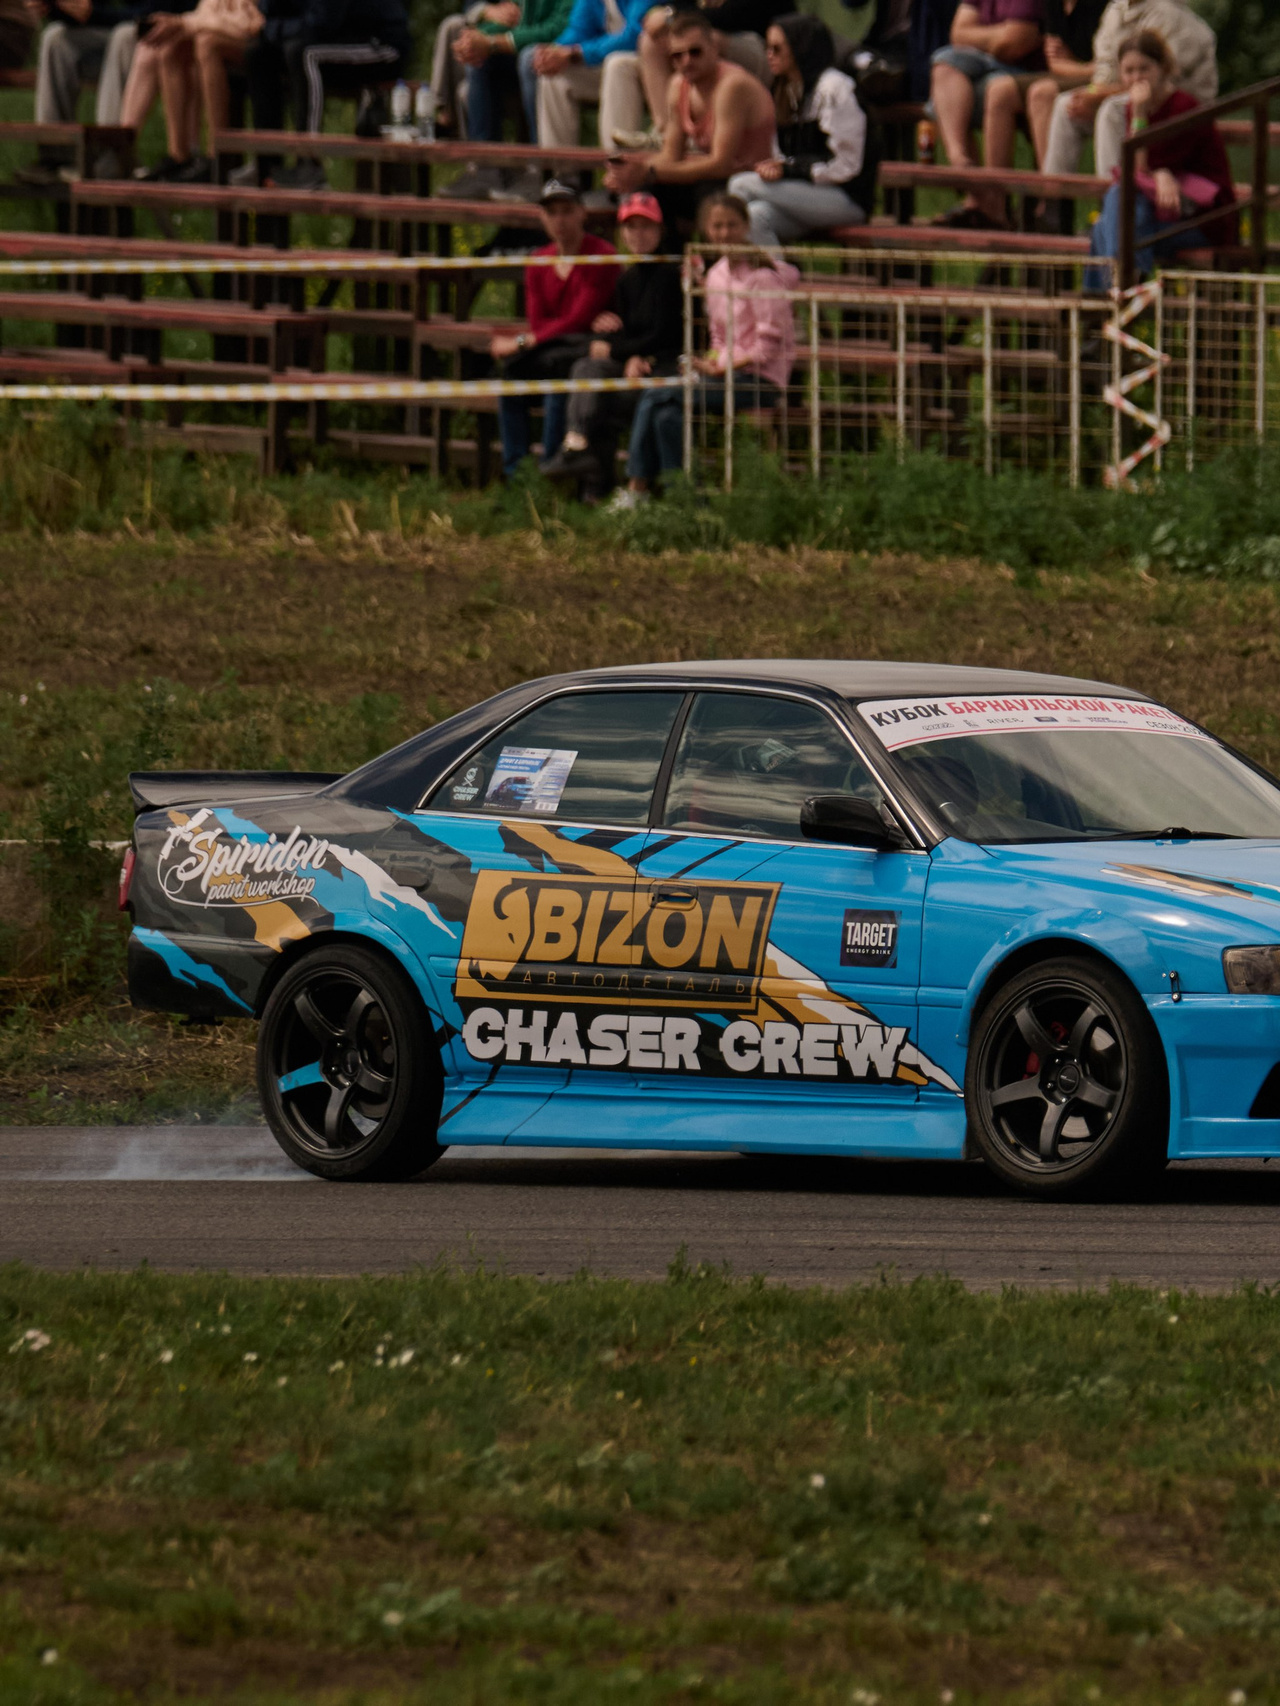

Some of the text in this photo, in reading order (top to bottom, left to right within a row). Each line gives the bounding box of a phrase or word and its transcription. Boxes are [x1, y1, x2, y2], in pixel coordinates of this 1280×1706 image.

[870, 704, 947, 727] КУБОК
[945, 698, 1112, 714] БАРНАУЛЬСКОЙ
[176, 825, 331, 895] Spiridon
[206, 871, 317, 910] paint workshop
[525, 888, 763, 970] BIZON
[846, 922, 898, 947] TARGET
[523, 970, 746, 994] АВТОДЕТАЛЬ
[462, 1007, 908, 1078] CHASER CREW
